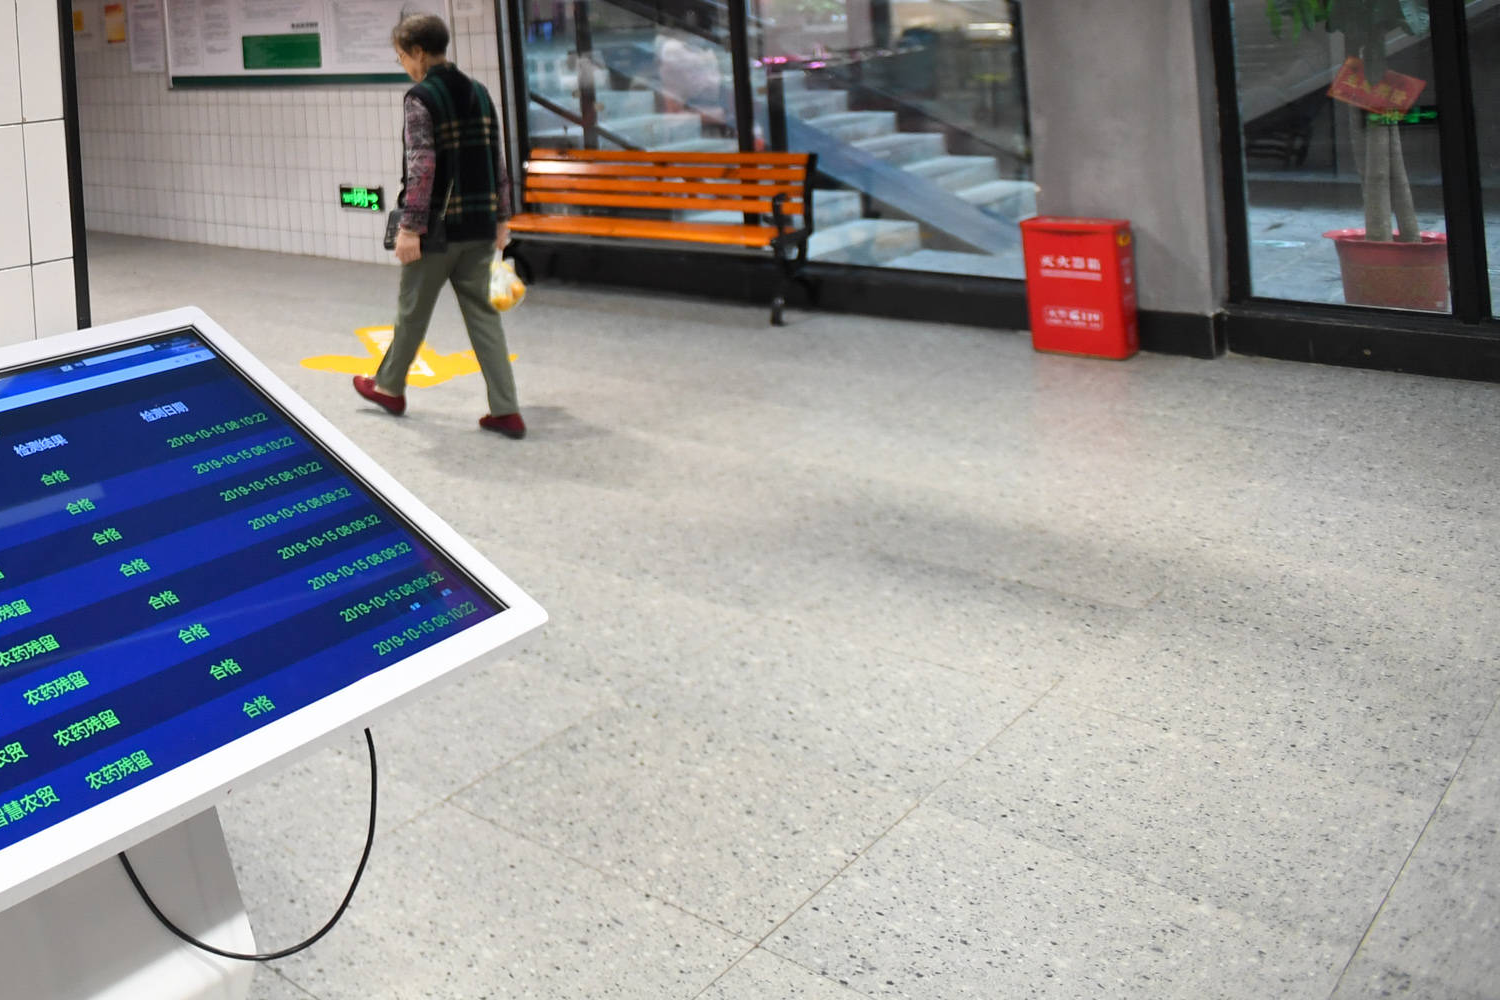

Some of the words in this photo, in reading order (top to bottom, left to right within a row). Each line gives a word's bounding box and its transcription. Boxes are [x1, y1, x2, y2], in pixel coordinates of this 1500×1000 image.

[13, 434, 68, 457] 检测结果
[139, 401, 190, 423] 检测日期
[40, 470, 71, 487] 合格
[167, 426, 223, 448] 2019-10-15
[224, 412, 269, 433] 08:10:22
[92, 527, 123, 546] 合格
[219, 476, 277, 501] 2019-10-15
[278, 462, 323, 484] 08:10:22
[178, 623, 211, 644] 合格
[307, 561, 367, 590] 2019-10-15
[367, 542, 412, 568] 08:09:32
[53, 709, 121, 747] 农药残留
